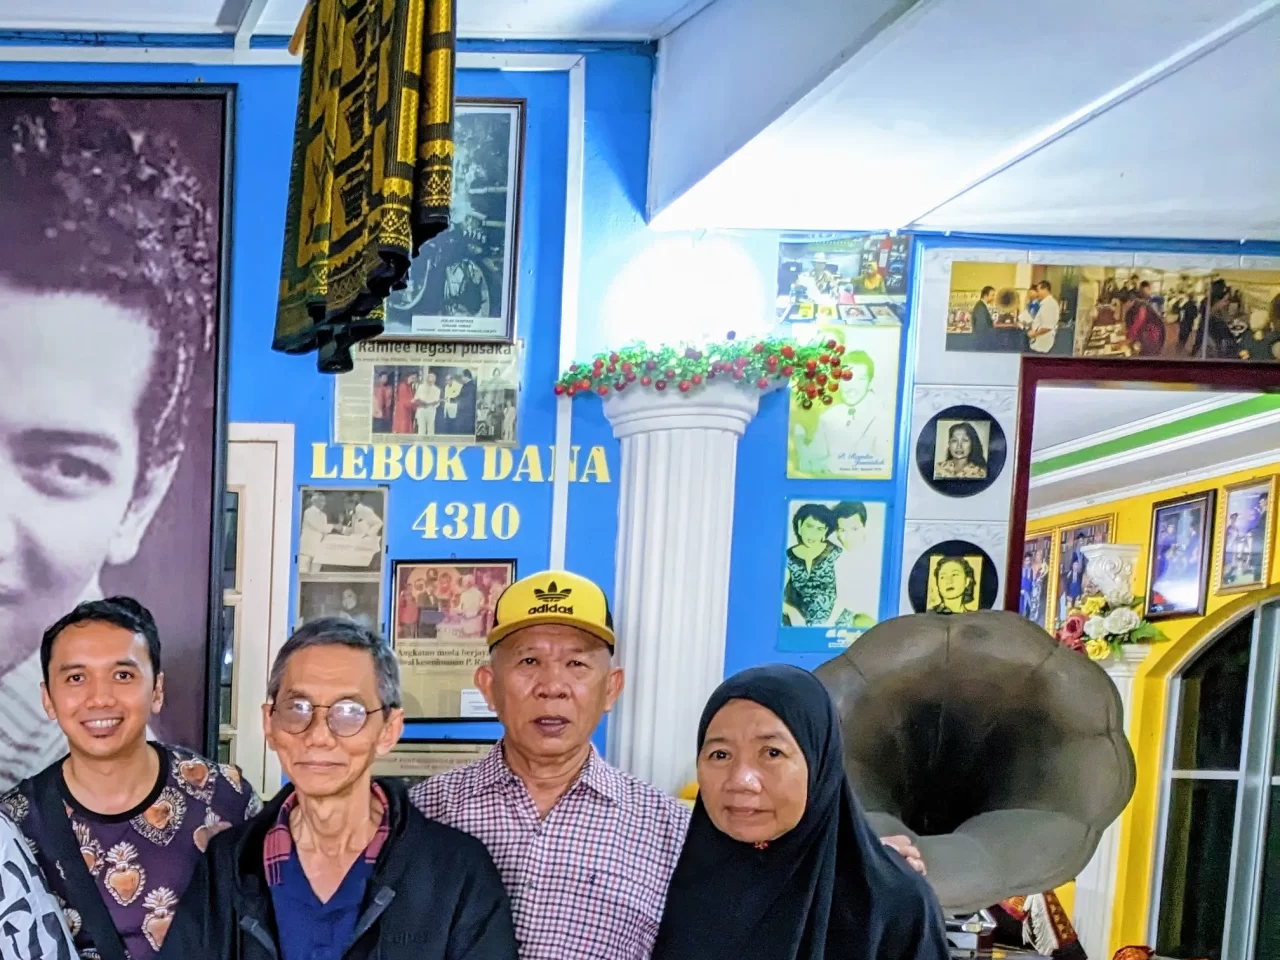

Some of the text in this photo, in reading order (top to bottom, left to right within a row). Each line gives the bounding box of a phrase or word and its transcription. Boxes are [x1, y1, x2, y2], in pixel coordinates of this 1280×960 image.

[310, 442, 469, 482] LEBOK
[412, 502, 520, 540] 4310
[528, 604, 573, 615] adidas
